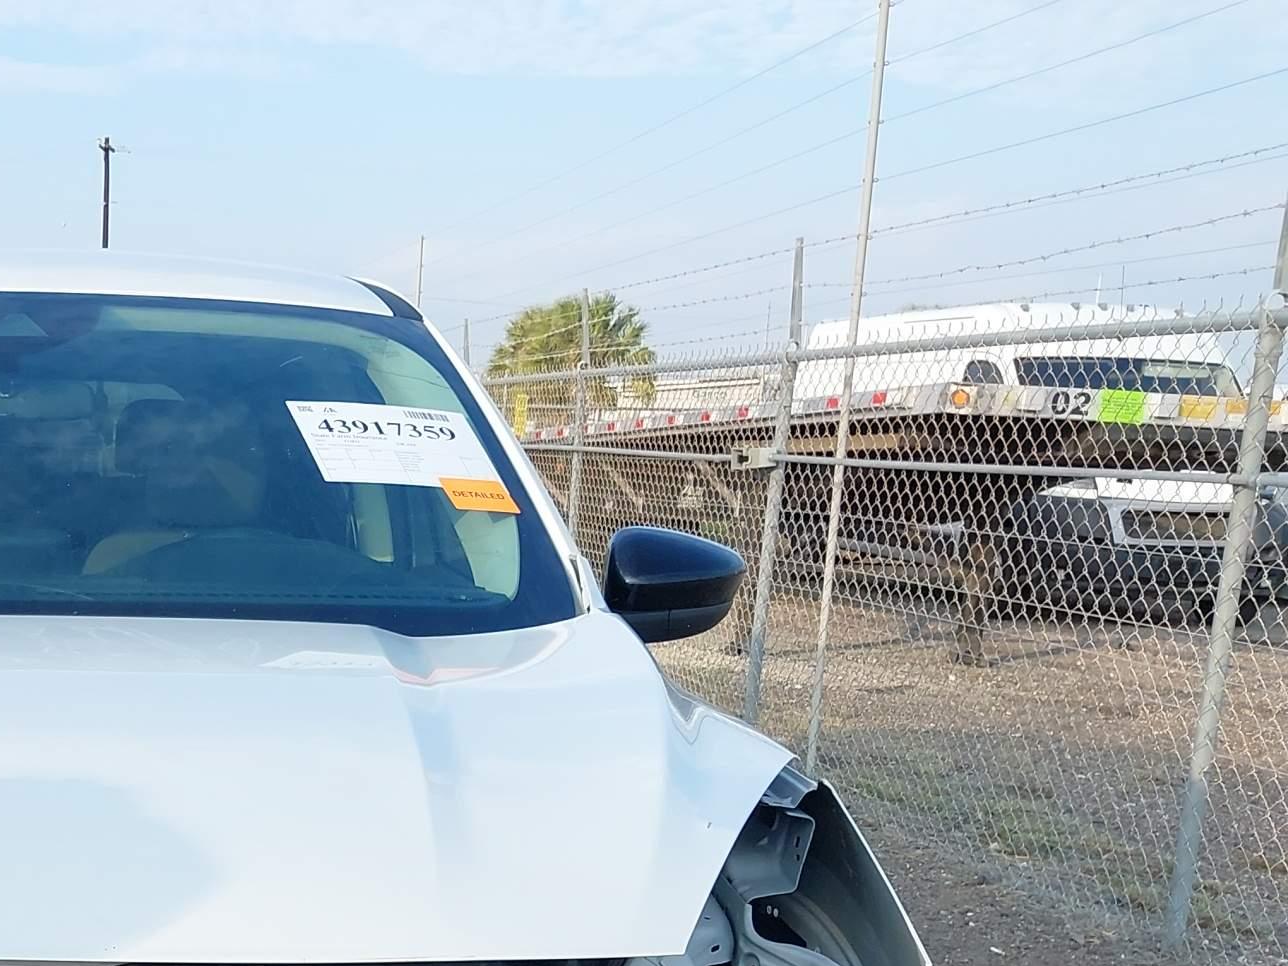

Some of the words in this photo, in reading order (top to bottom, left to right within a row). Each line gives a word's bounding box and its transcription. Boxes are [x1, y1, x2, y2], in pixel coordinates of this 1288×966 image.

[1051, 391, 1091, 416] 02
[318, 418, 457, 441] 43917359
[451, 490, 506, 500] DETAILED
